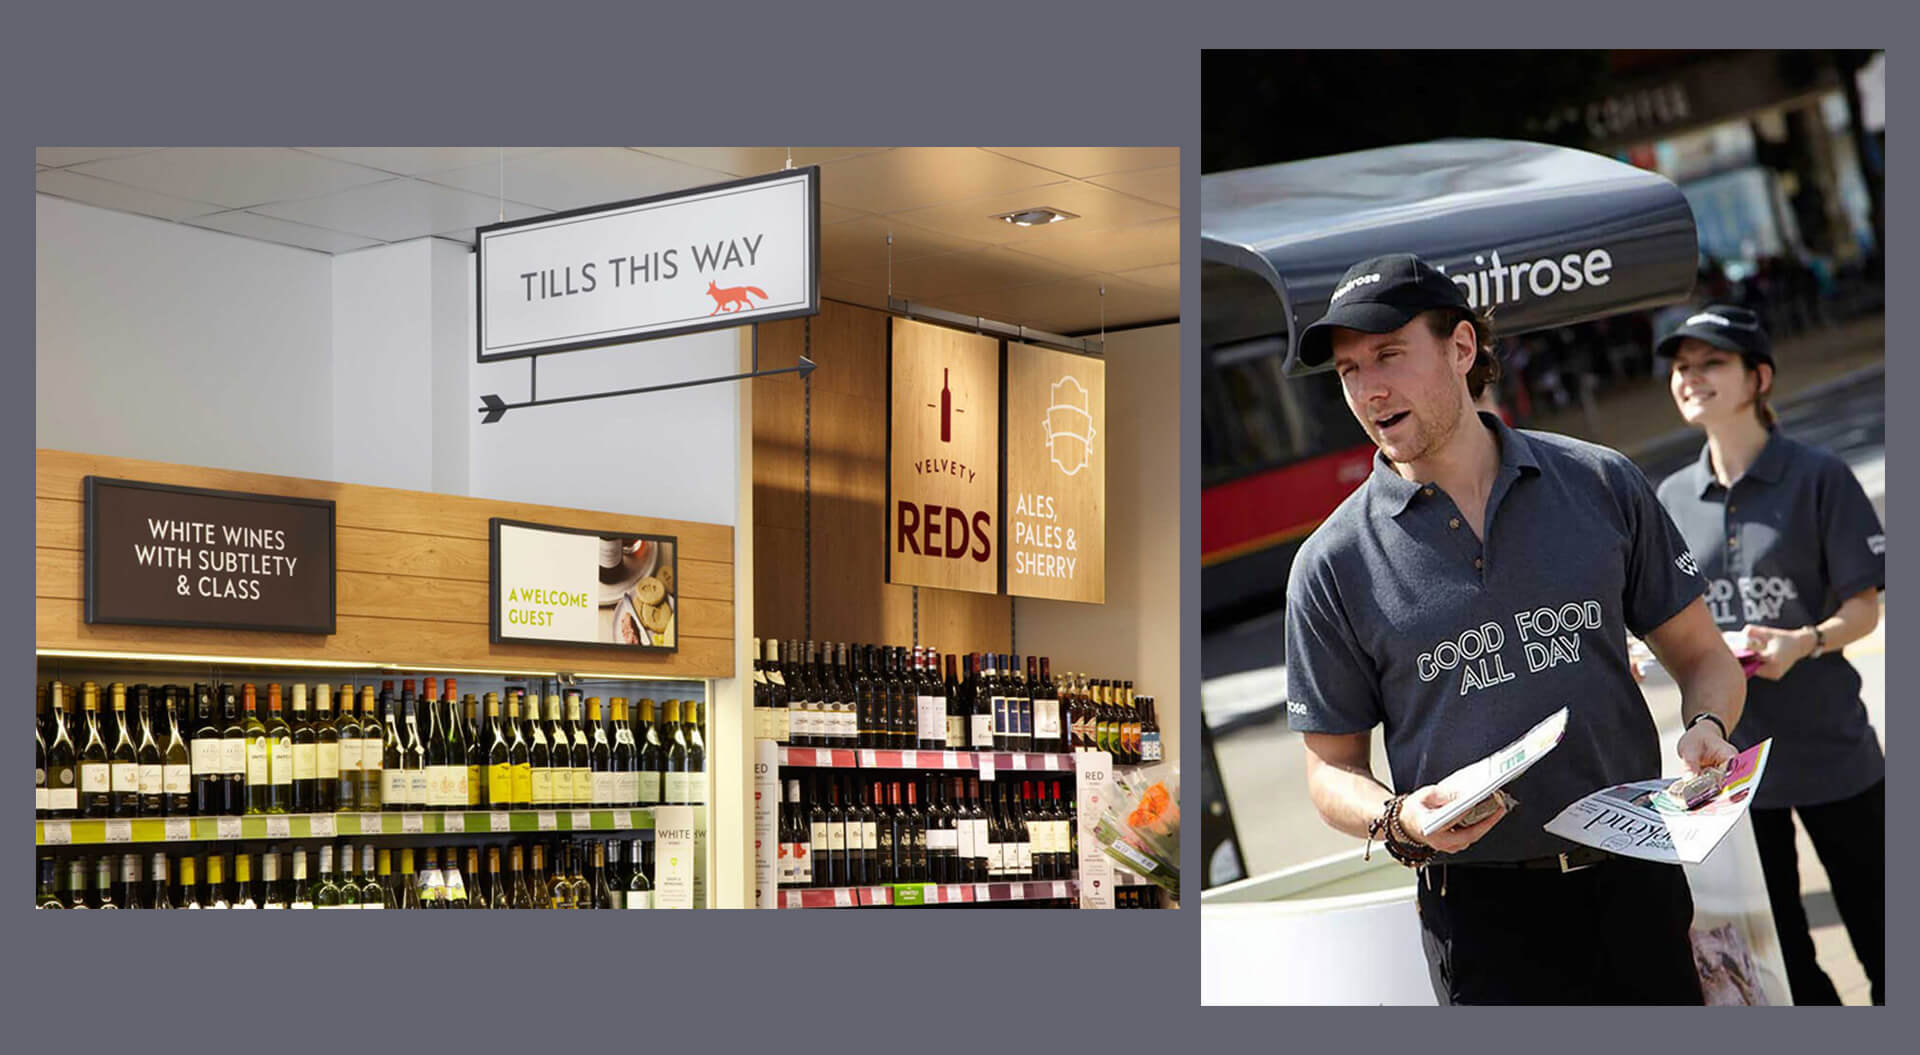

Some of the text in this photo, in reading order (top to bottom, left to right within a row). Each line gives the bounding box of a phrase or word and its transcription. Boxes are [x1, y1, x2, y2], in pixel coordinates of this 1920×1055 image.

[521, 234, 763, 302] TILLS THIS WAY
[1436, 249, 1612, 309] aitrose
[915, 458, 976, 484] VELVETY
[1016, 493, 1057, 522] ALES,
[148, 518, 285, 550] WHITE WINES
[897, 500, 991, 563] REDS
[1016, 521, 1077, 550] PALES &
[134, 544, 297, 577] WITH SUBTLETY
[1016, 551, 1077, 580] SHERRY
[176, 574, 261, 600] & CLASS
[508, 587, 588, 608] A WELCOME
[508, 609, 554, 627] GUEST
[1711, 597, 1784, 623] LL DAY
[1417, 600, 1601, 682] GOOD FOOD
[1460, 633, 1580, 696] ALL DAY
[754, 763, 769, 774] ED
[1085, 771, 1105, 781] RED
[658, 829, 691, 840] WHITE
[1583, 809, 1672, 847] ekend
